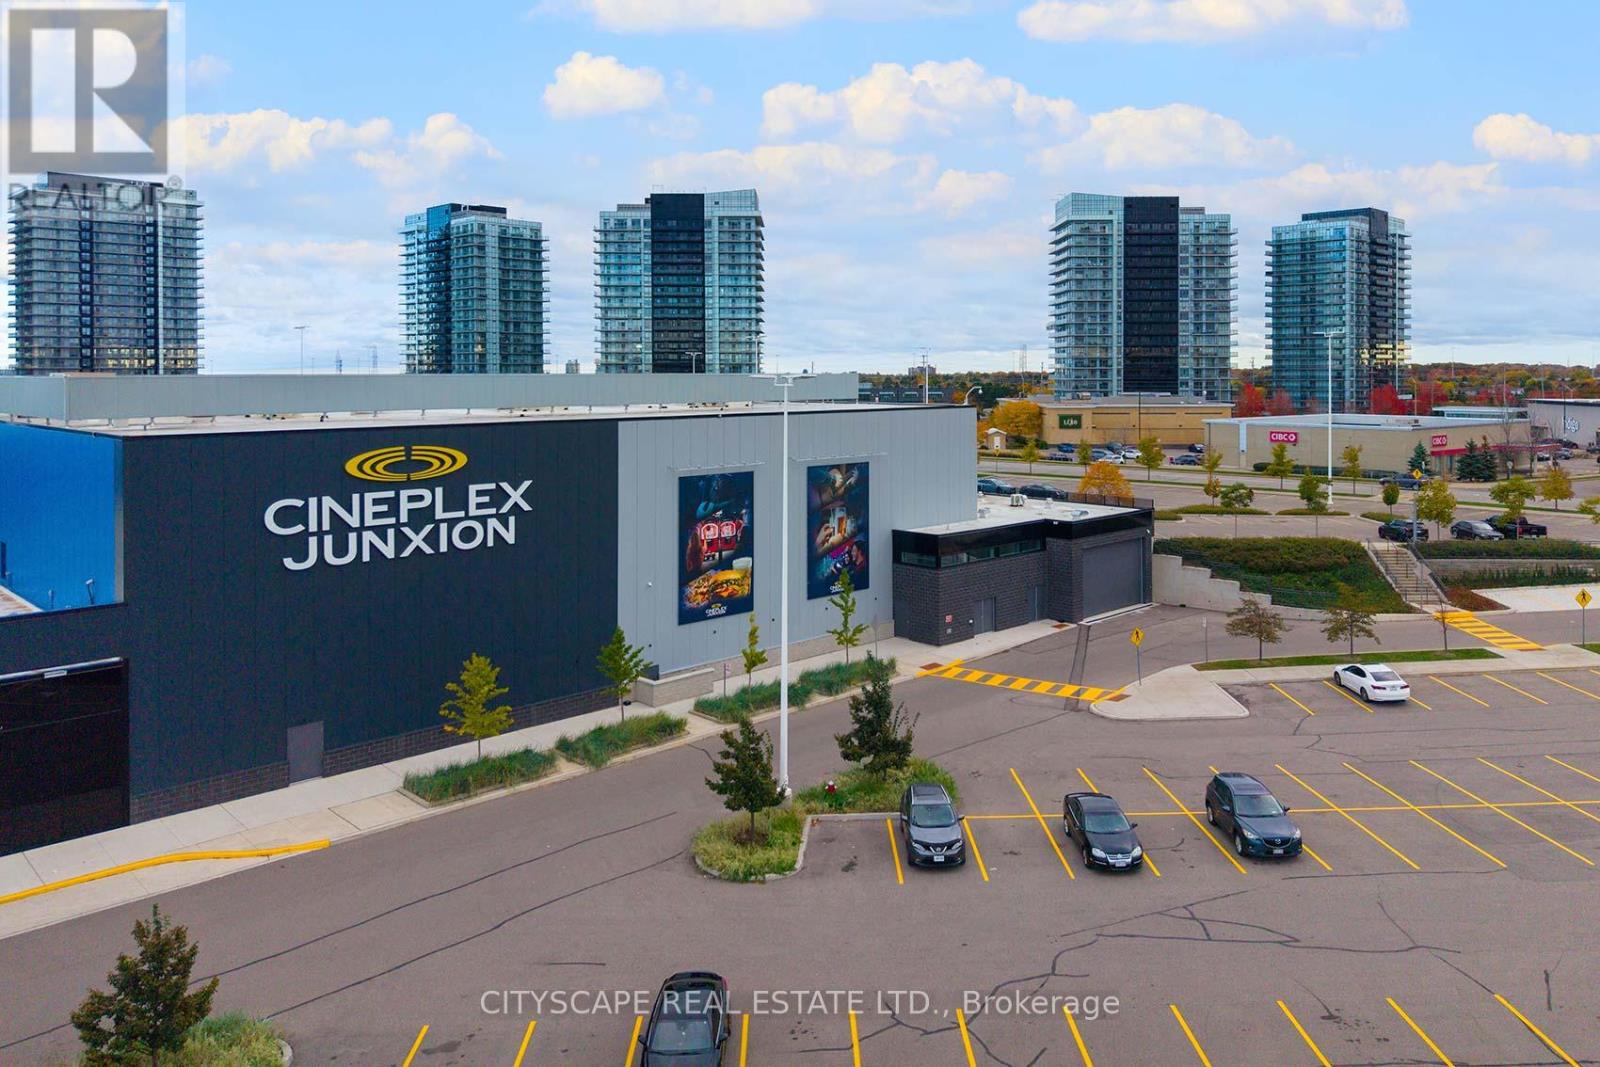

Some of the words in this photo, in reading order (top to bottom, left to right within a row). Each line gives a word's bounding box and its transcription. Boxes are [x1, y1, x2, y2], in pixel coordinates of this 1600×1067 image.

[1271, 433, 1288, 441] CIBC
[264, 480, 533, 535] CINEPLEX
[283, 516, 516, 571] JUNXION
